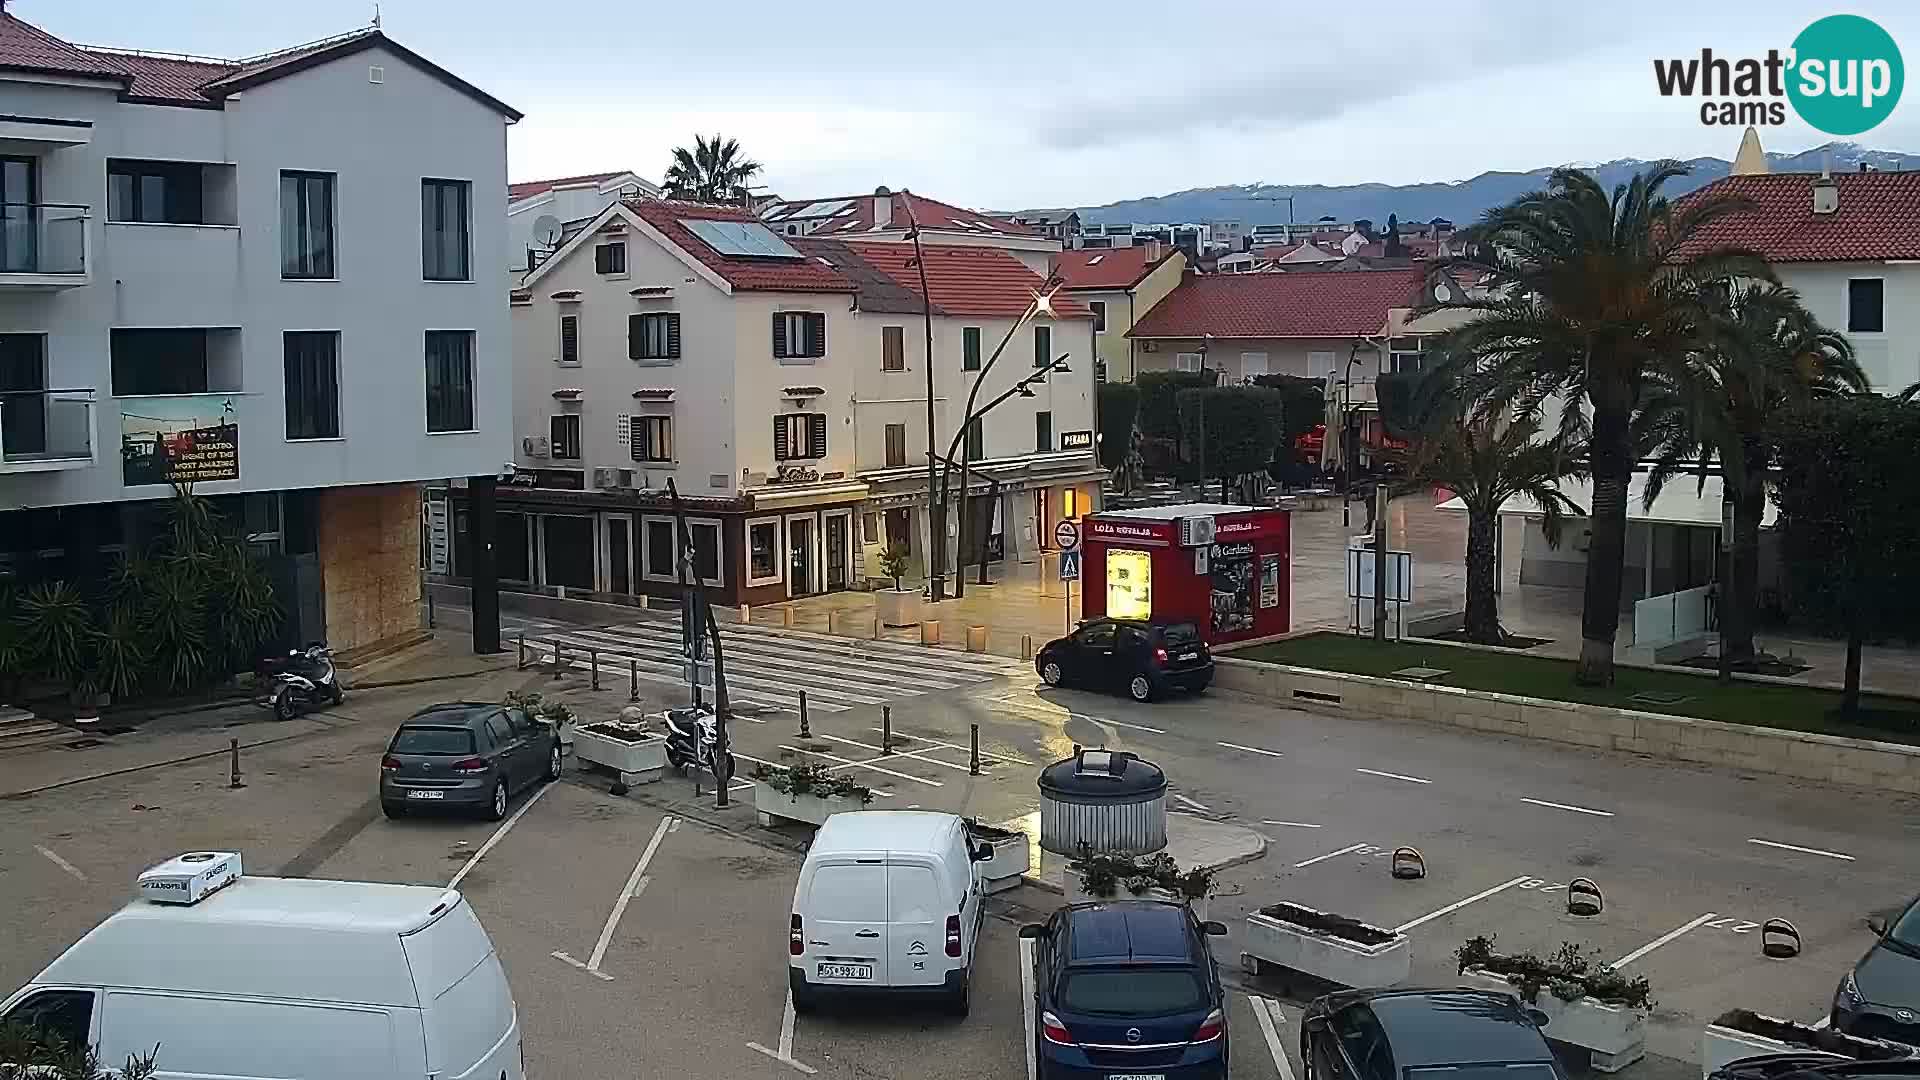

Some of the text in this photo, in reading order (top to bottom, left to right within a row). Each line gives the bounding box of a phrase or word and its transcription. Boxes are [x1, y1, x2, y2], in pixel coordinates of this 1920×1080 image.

[207, 451, 217, 459] OF
[174, 459, 235, 470] MOST AMAZING
